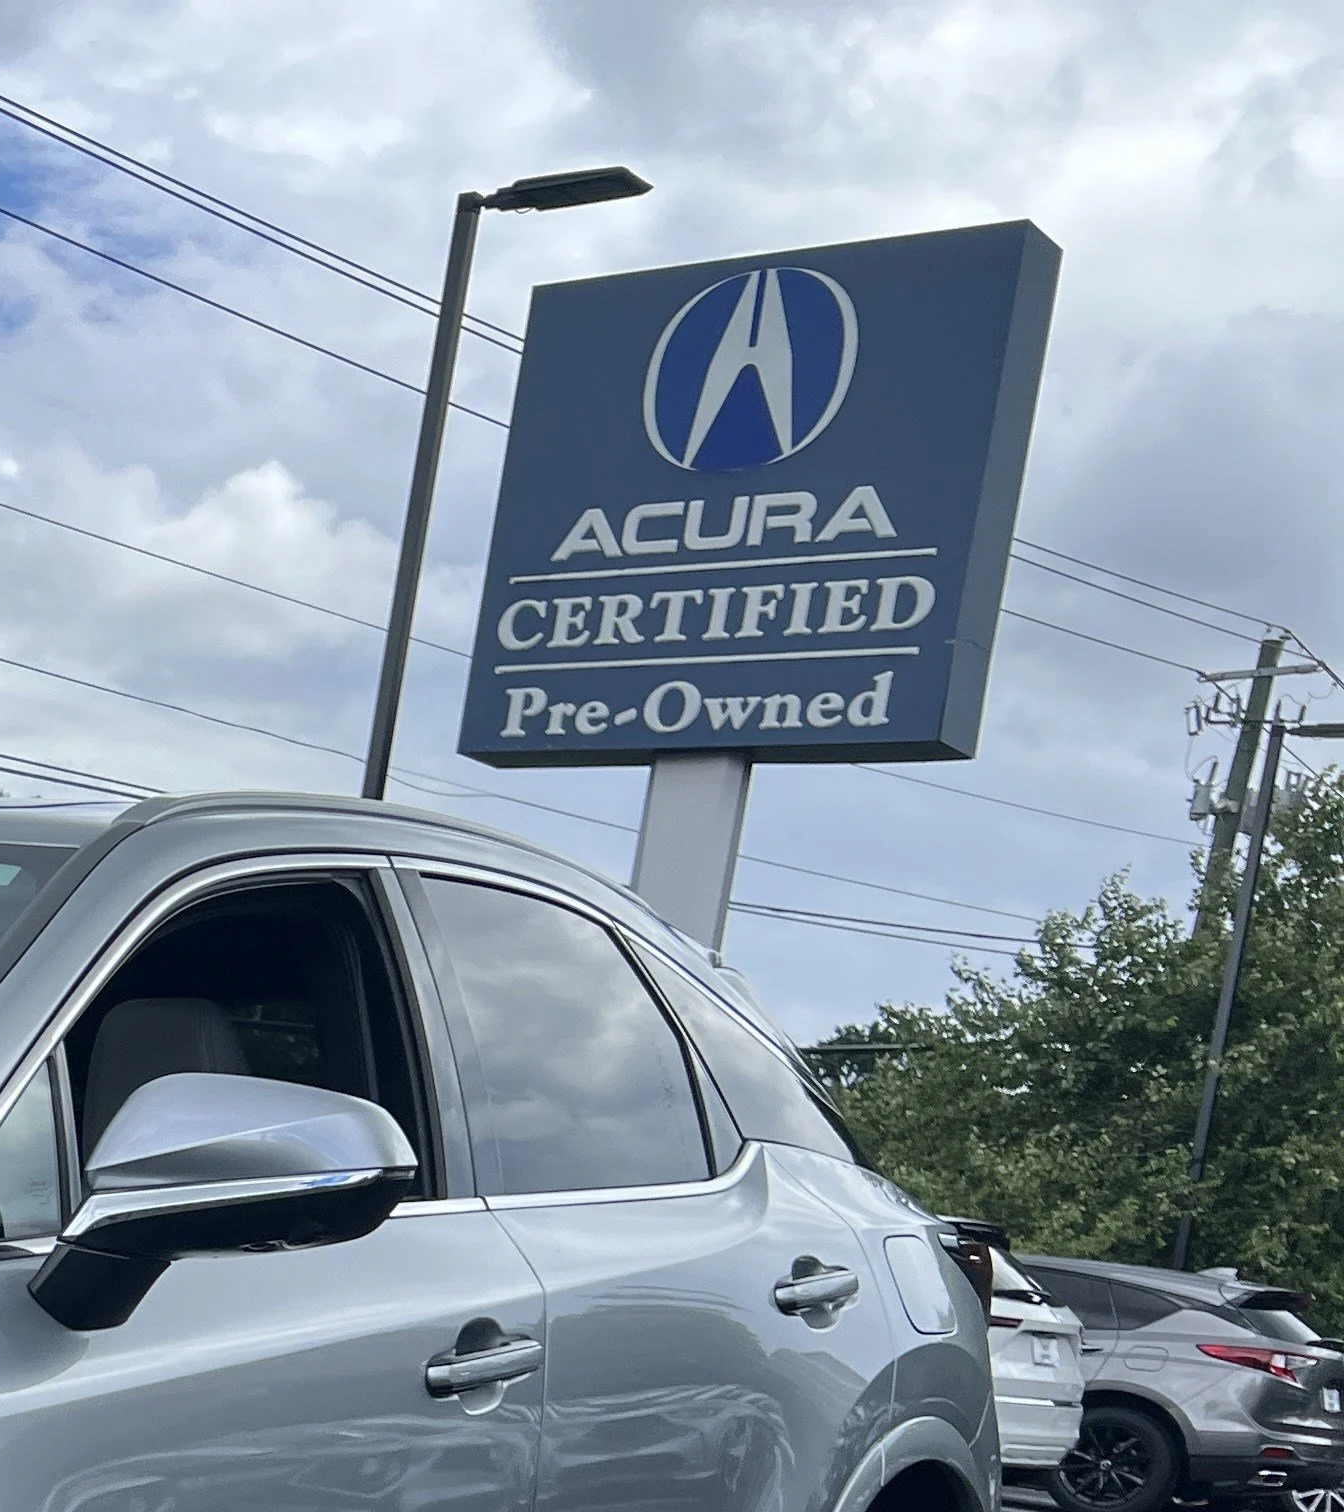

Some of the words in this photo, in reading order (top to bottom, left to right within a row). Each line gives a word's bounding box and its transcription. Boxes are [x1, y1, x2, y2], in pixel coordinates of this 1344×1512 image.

[549, 484, 898, 563] ACURA
[496, 575, 937, 652] CERTIFIED
[499, 670, 896, 739] Pre-Owned
